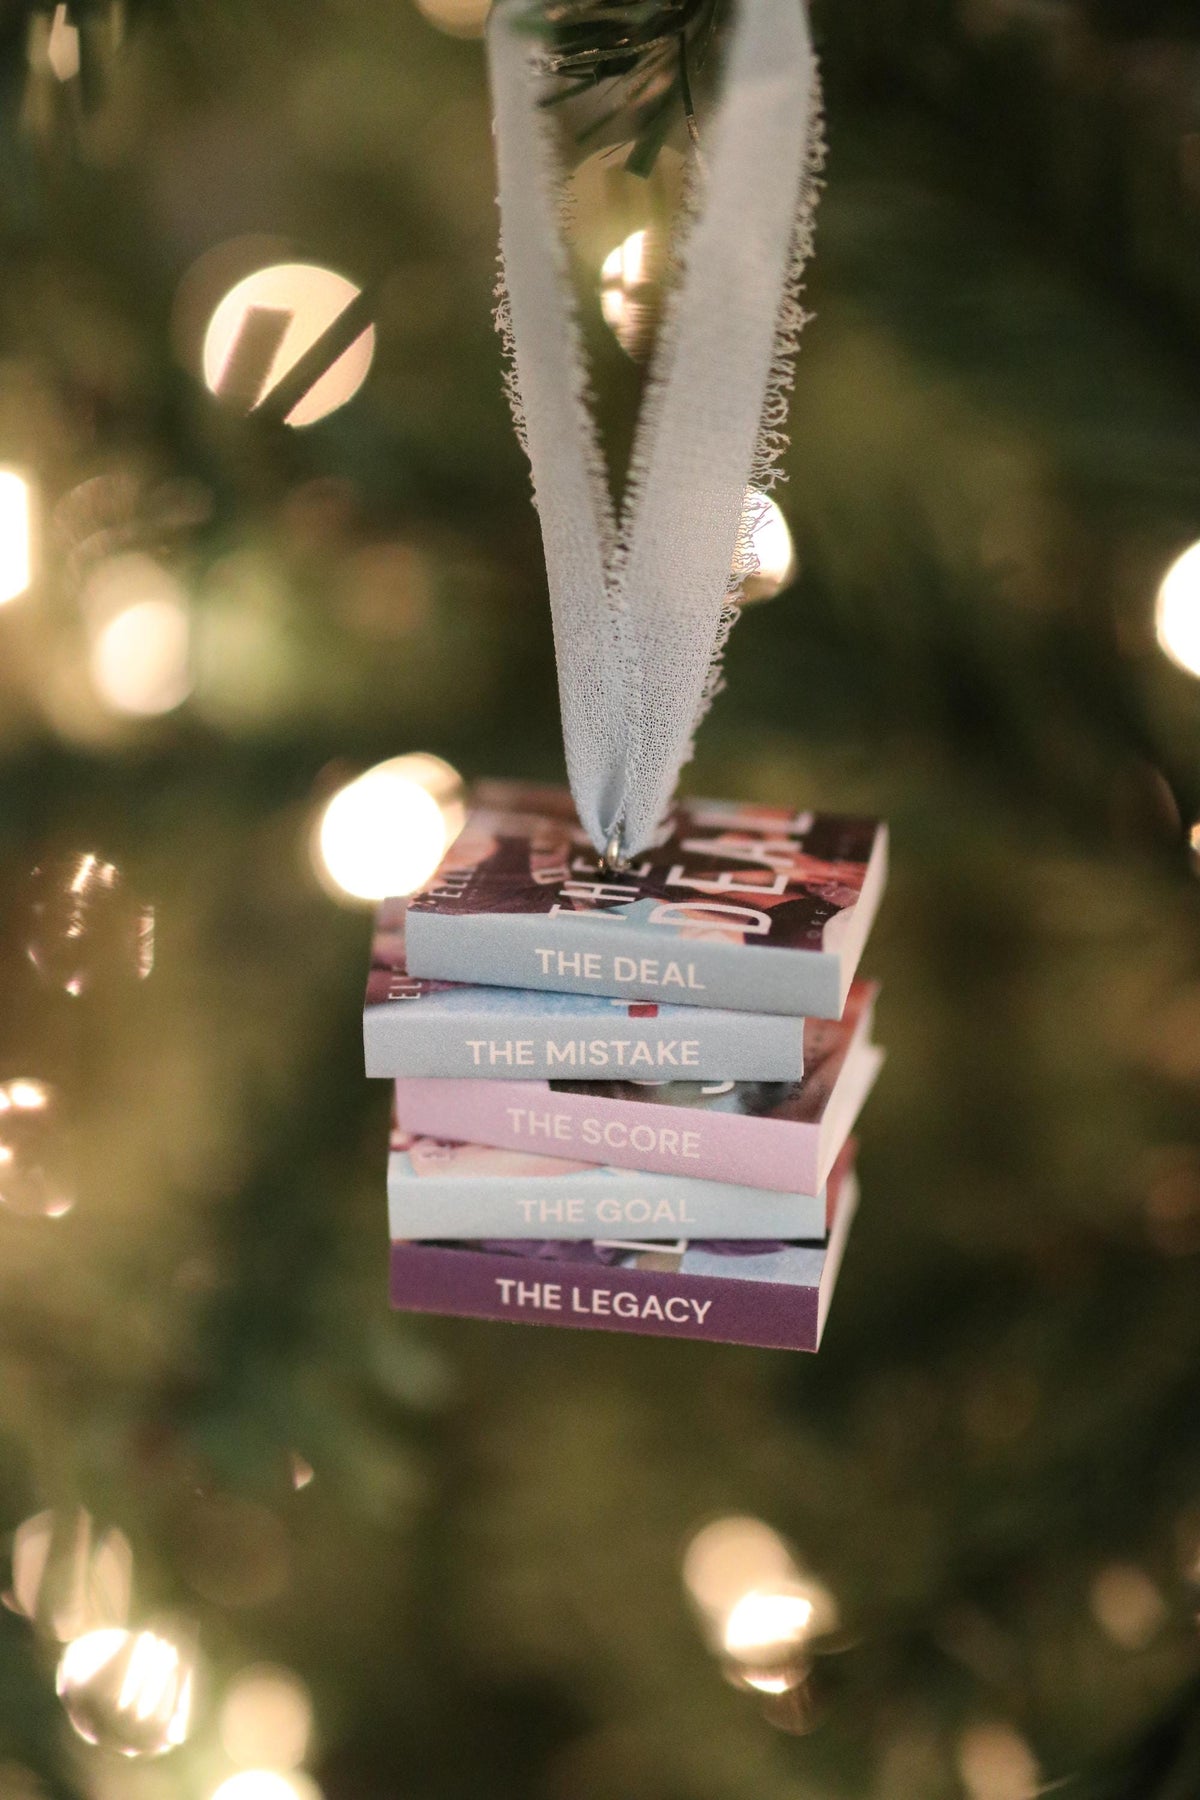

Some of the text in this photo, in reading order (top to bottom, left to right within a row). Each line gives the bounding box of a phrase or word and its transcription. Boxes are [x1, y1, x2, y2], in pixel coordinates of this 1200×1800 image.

[548, 854, 652, 921] THE
[650, 812, 814, 935] DEAL
[535, 948, 706, 990] THE DEAL
[465, 1040, 700, 1066] THE MISTAKE
[507, 1107, 701, 1159] THE SCORE
[516, 1198, 697, 1223] THE GOAL
[495, 1278, 713, 1325] THE LEGACY
